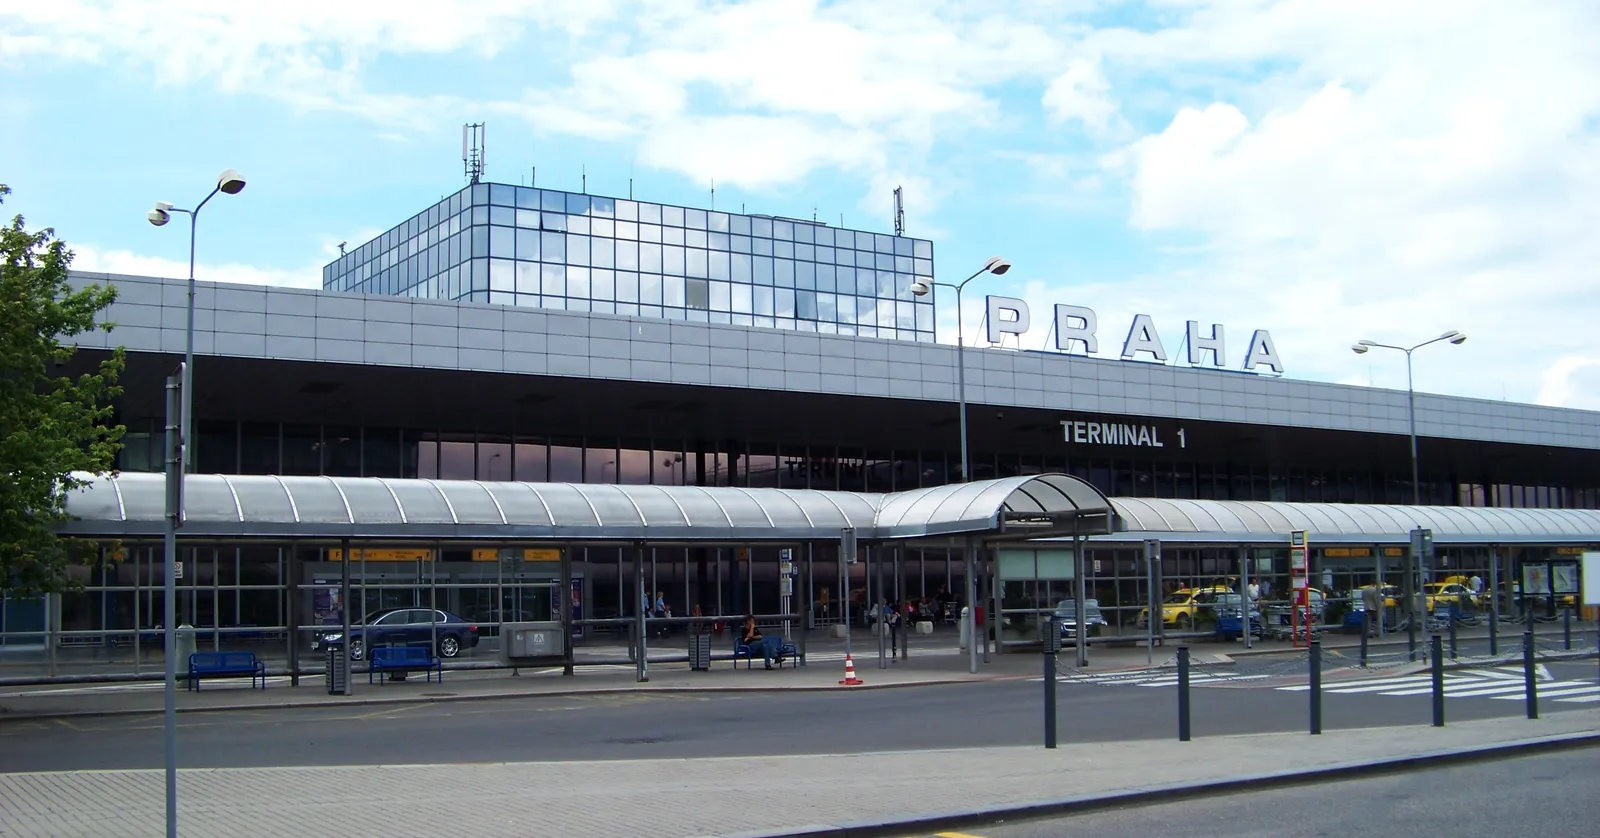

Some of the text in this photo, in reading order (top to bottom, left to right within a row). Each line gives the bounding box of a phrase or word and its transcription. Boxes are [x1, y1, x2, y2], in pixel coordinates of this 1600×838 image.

[986, 295, 1284, 373] PRAHA
[1060, 420, 1186, 448] TERMINAL 1
